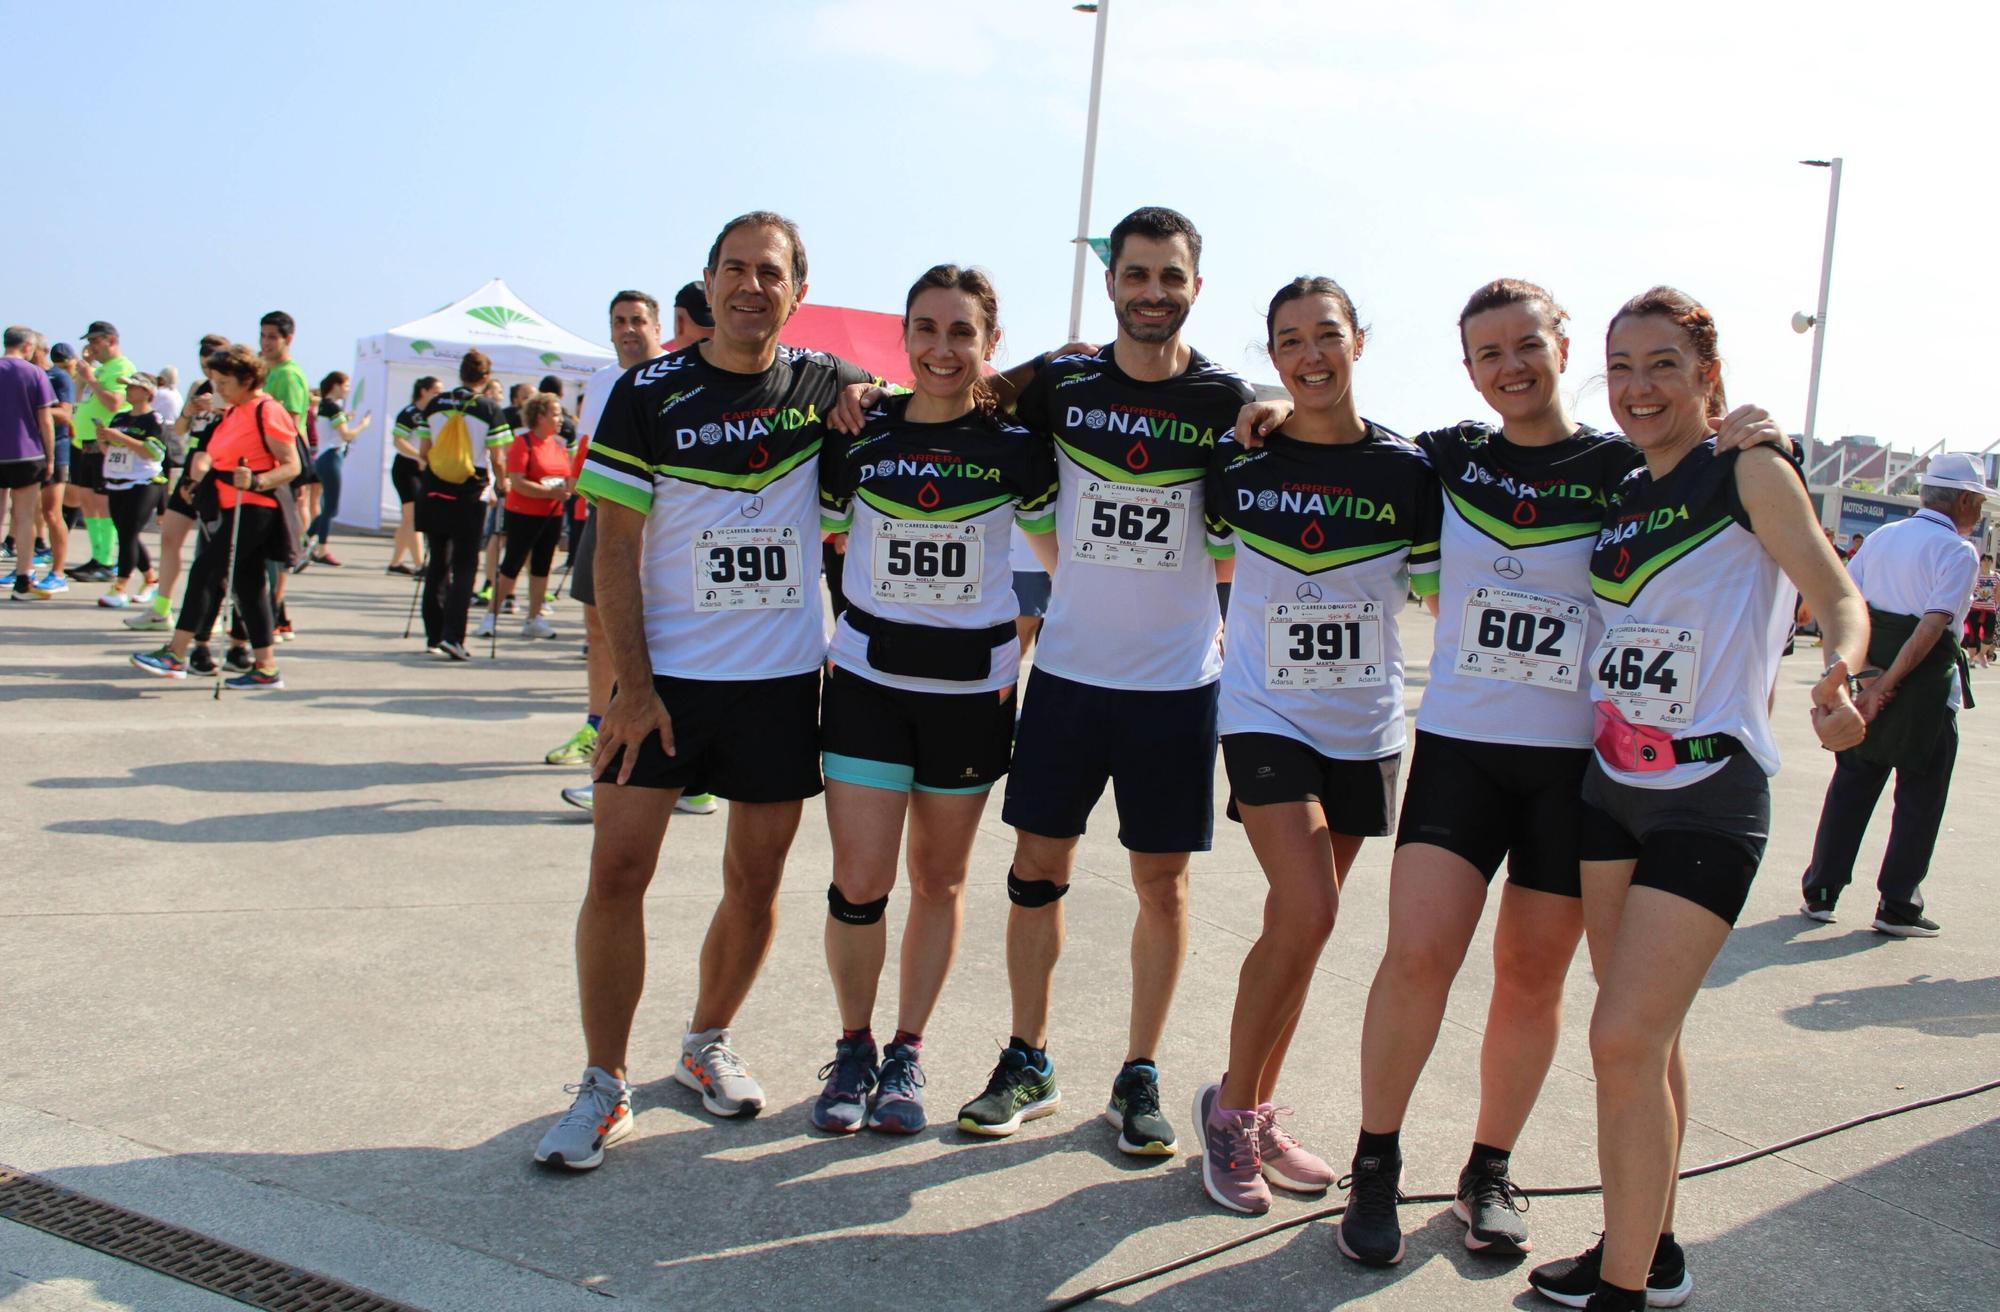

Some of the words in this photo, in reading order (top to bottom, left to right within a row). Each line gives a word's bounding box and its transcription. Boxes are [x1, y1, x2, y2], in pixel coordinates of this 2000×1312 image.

[676, 404, 821, 450] DONAVIDA
[722, 406, 777, 421] CARRER
[1066, 406, 1215, 449] DONAVIDA
[1110, 403, 1177, 419] CARRERA
[859, 459, 1000, 482] DONAVIDA
[1281, 481, 1354, 496] CARRERA
[1092, 501, 1170, 544] 562
[1237, 488, 1397, 525] DONAVIDA
[1843, 501, 1863, 514] MOTOS
[1869, 506, 1884, 517] AGUA
[710, 546, 787, 583] 390
[888, 540, 966, 577] 560
[1289, 623, 1360, 660] 391
[1478, 609, 1565, 657] 602
[1599, 647, 1678, 693] 464
[1660, 715, 1687, 723] Adarsa
